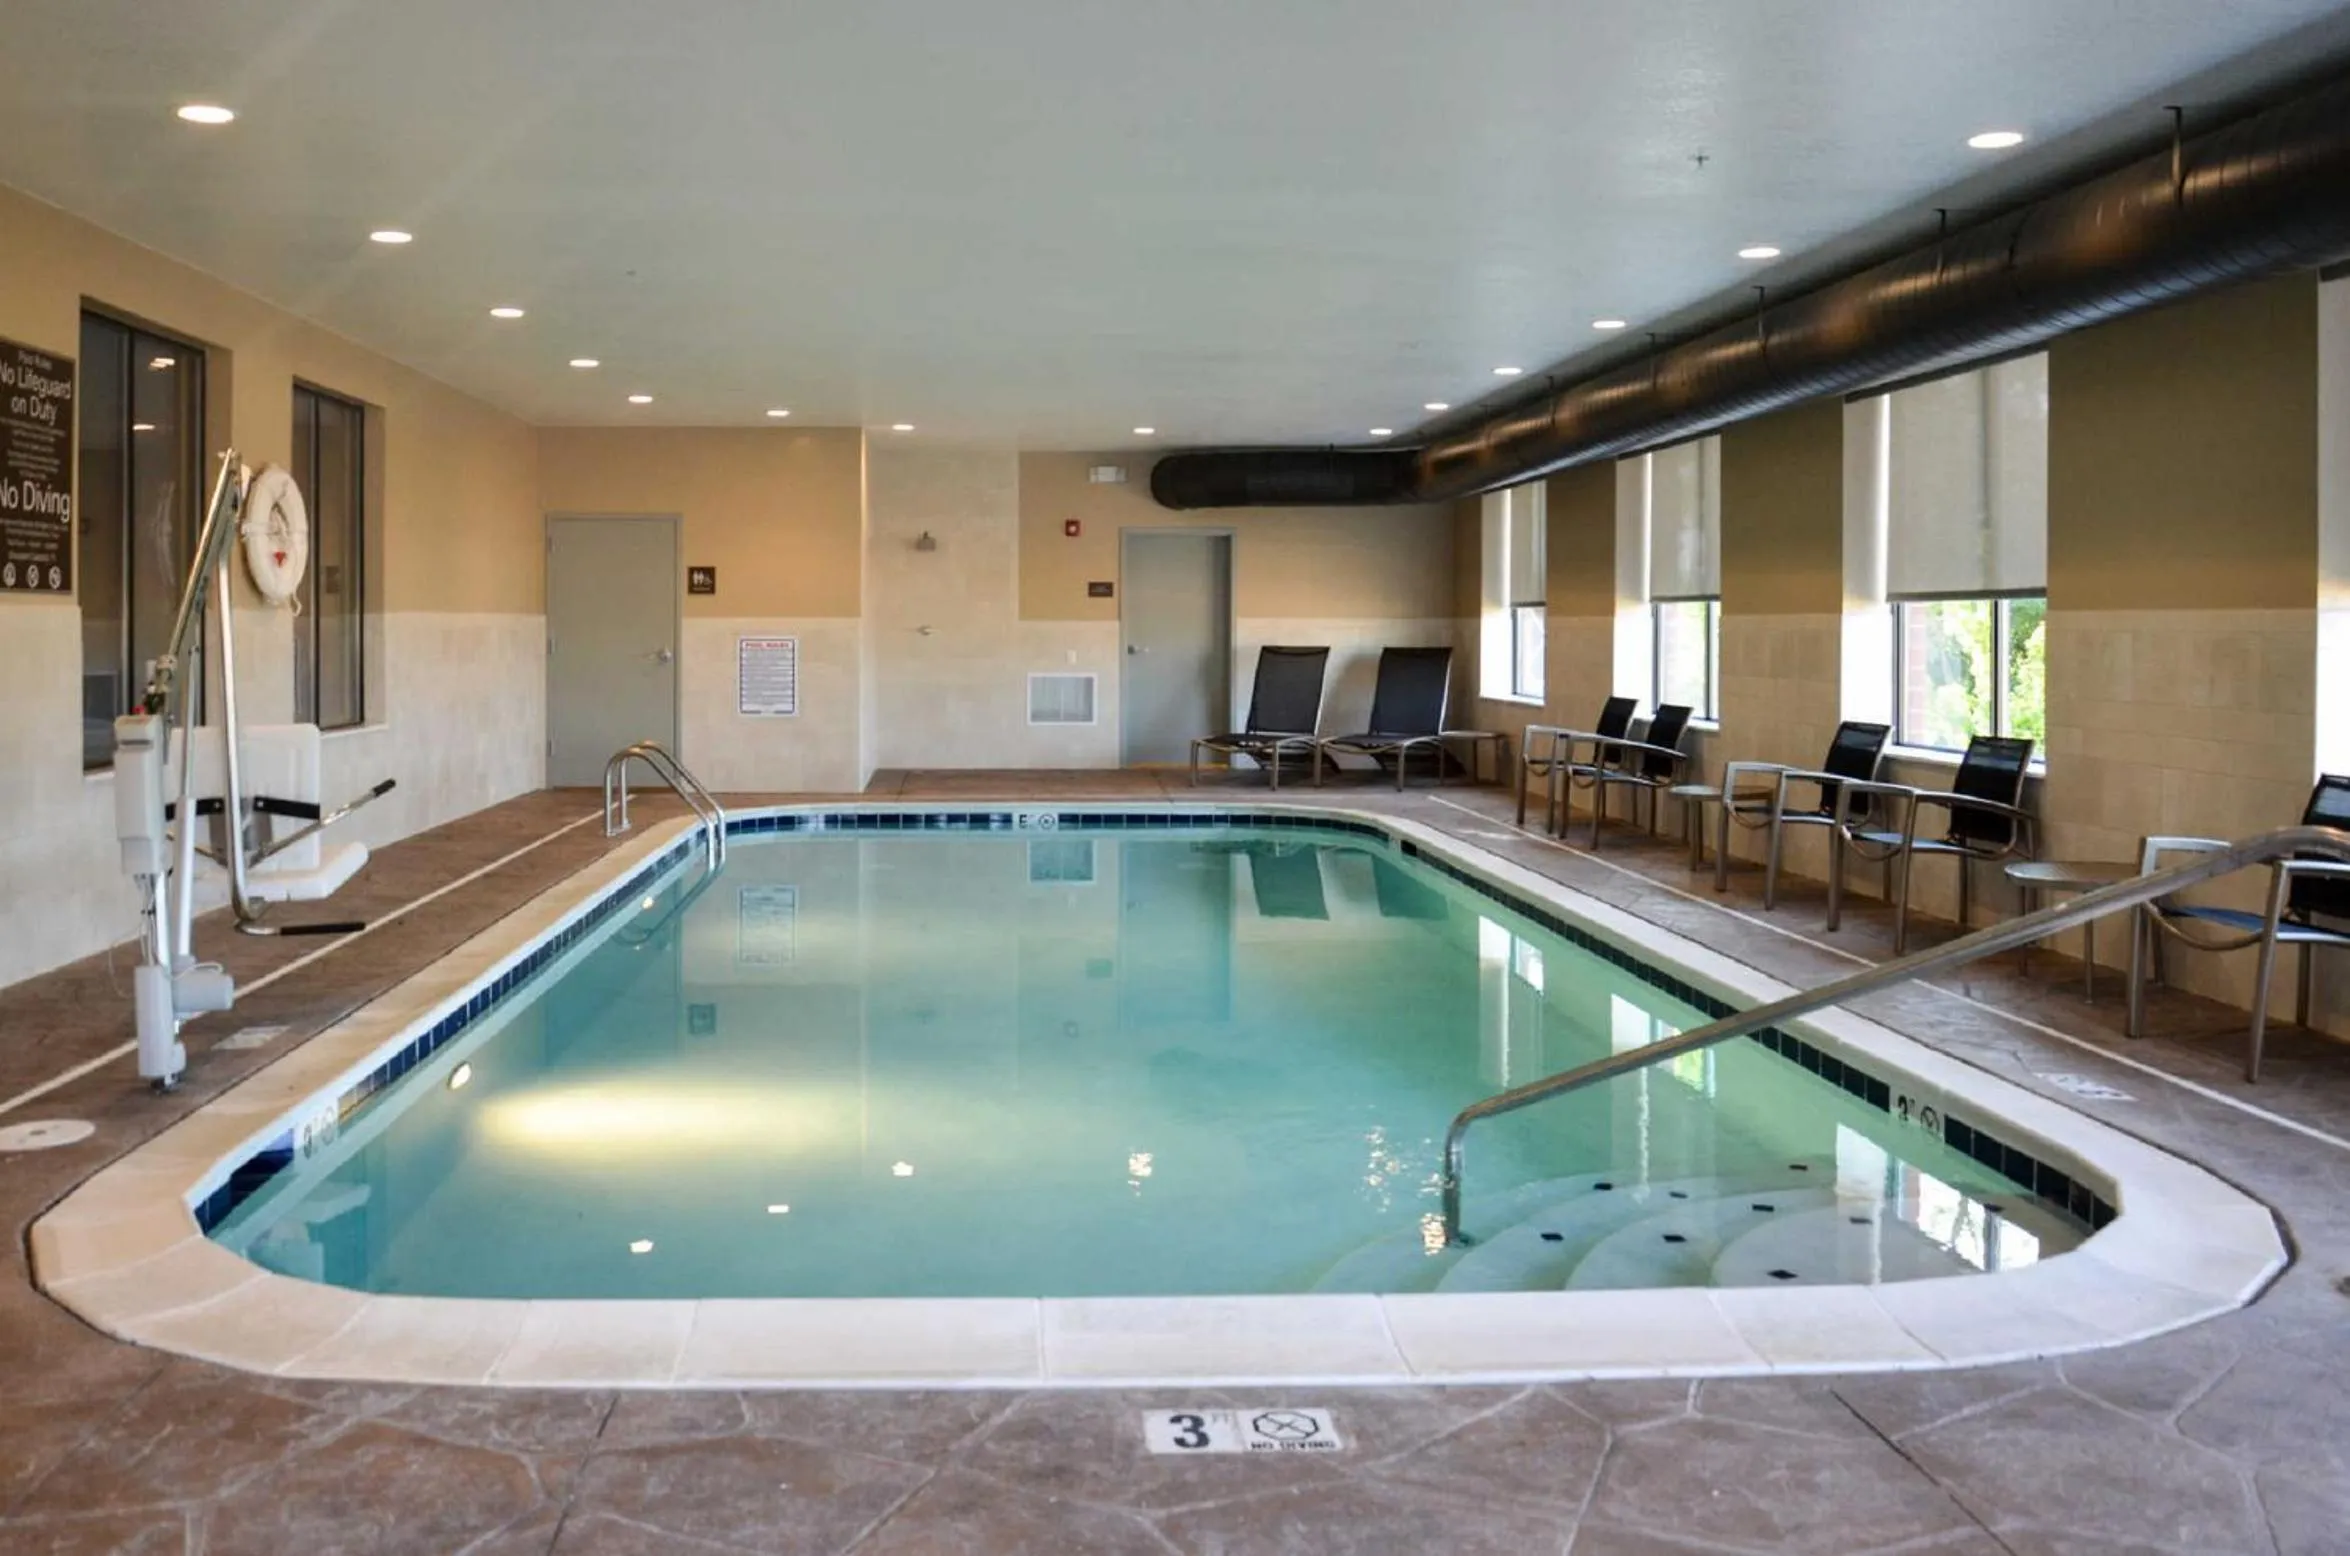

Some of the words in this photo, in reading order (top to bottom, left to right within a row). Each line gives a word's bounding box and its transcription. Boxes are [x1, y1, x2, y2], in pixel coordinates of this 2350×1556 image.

[0, 360, 16, 386] No
[18, 366, 72, 399] Lifeguard
[11, 396, 27, 415] on
[30, 396, 58, 427] Duty
[0, 477, 19, 509] No
[23, 480, 71, 524] Diving
[1169, 1414, 1210, 1449] 3
